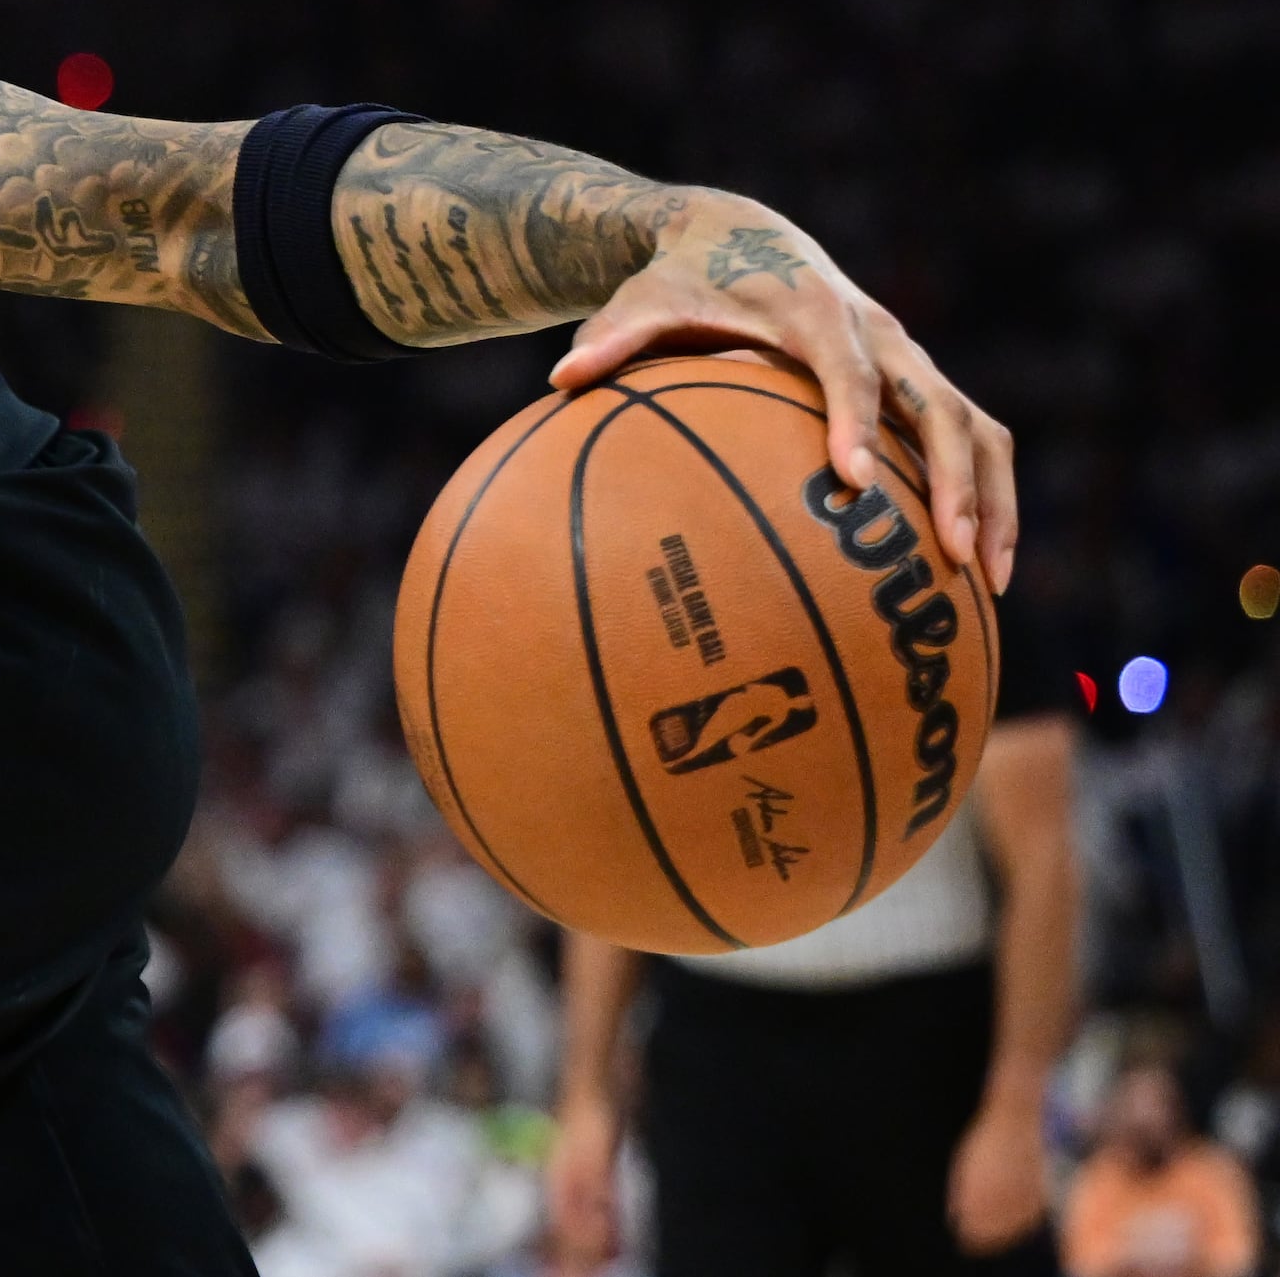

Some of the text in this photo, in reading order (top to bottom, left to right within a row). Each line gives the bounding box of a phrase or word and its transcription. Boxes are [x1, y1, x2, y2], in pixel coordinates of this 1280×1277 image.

[659, 534, 727, 667] OFFICIAL GAME BALL
[801, 464, 959, 843] Wilson
